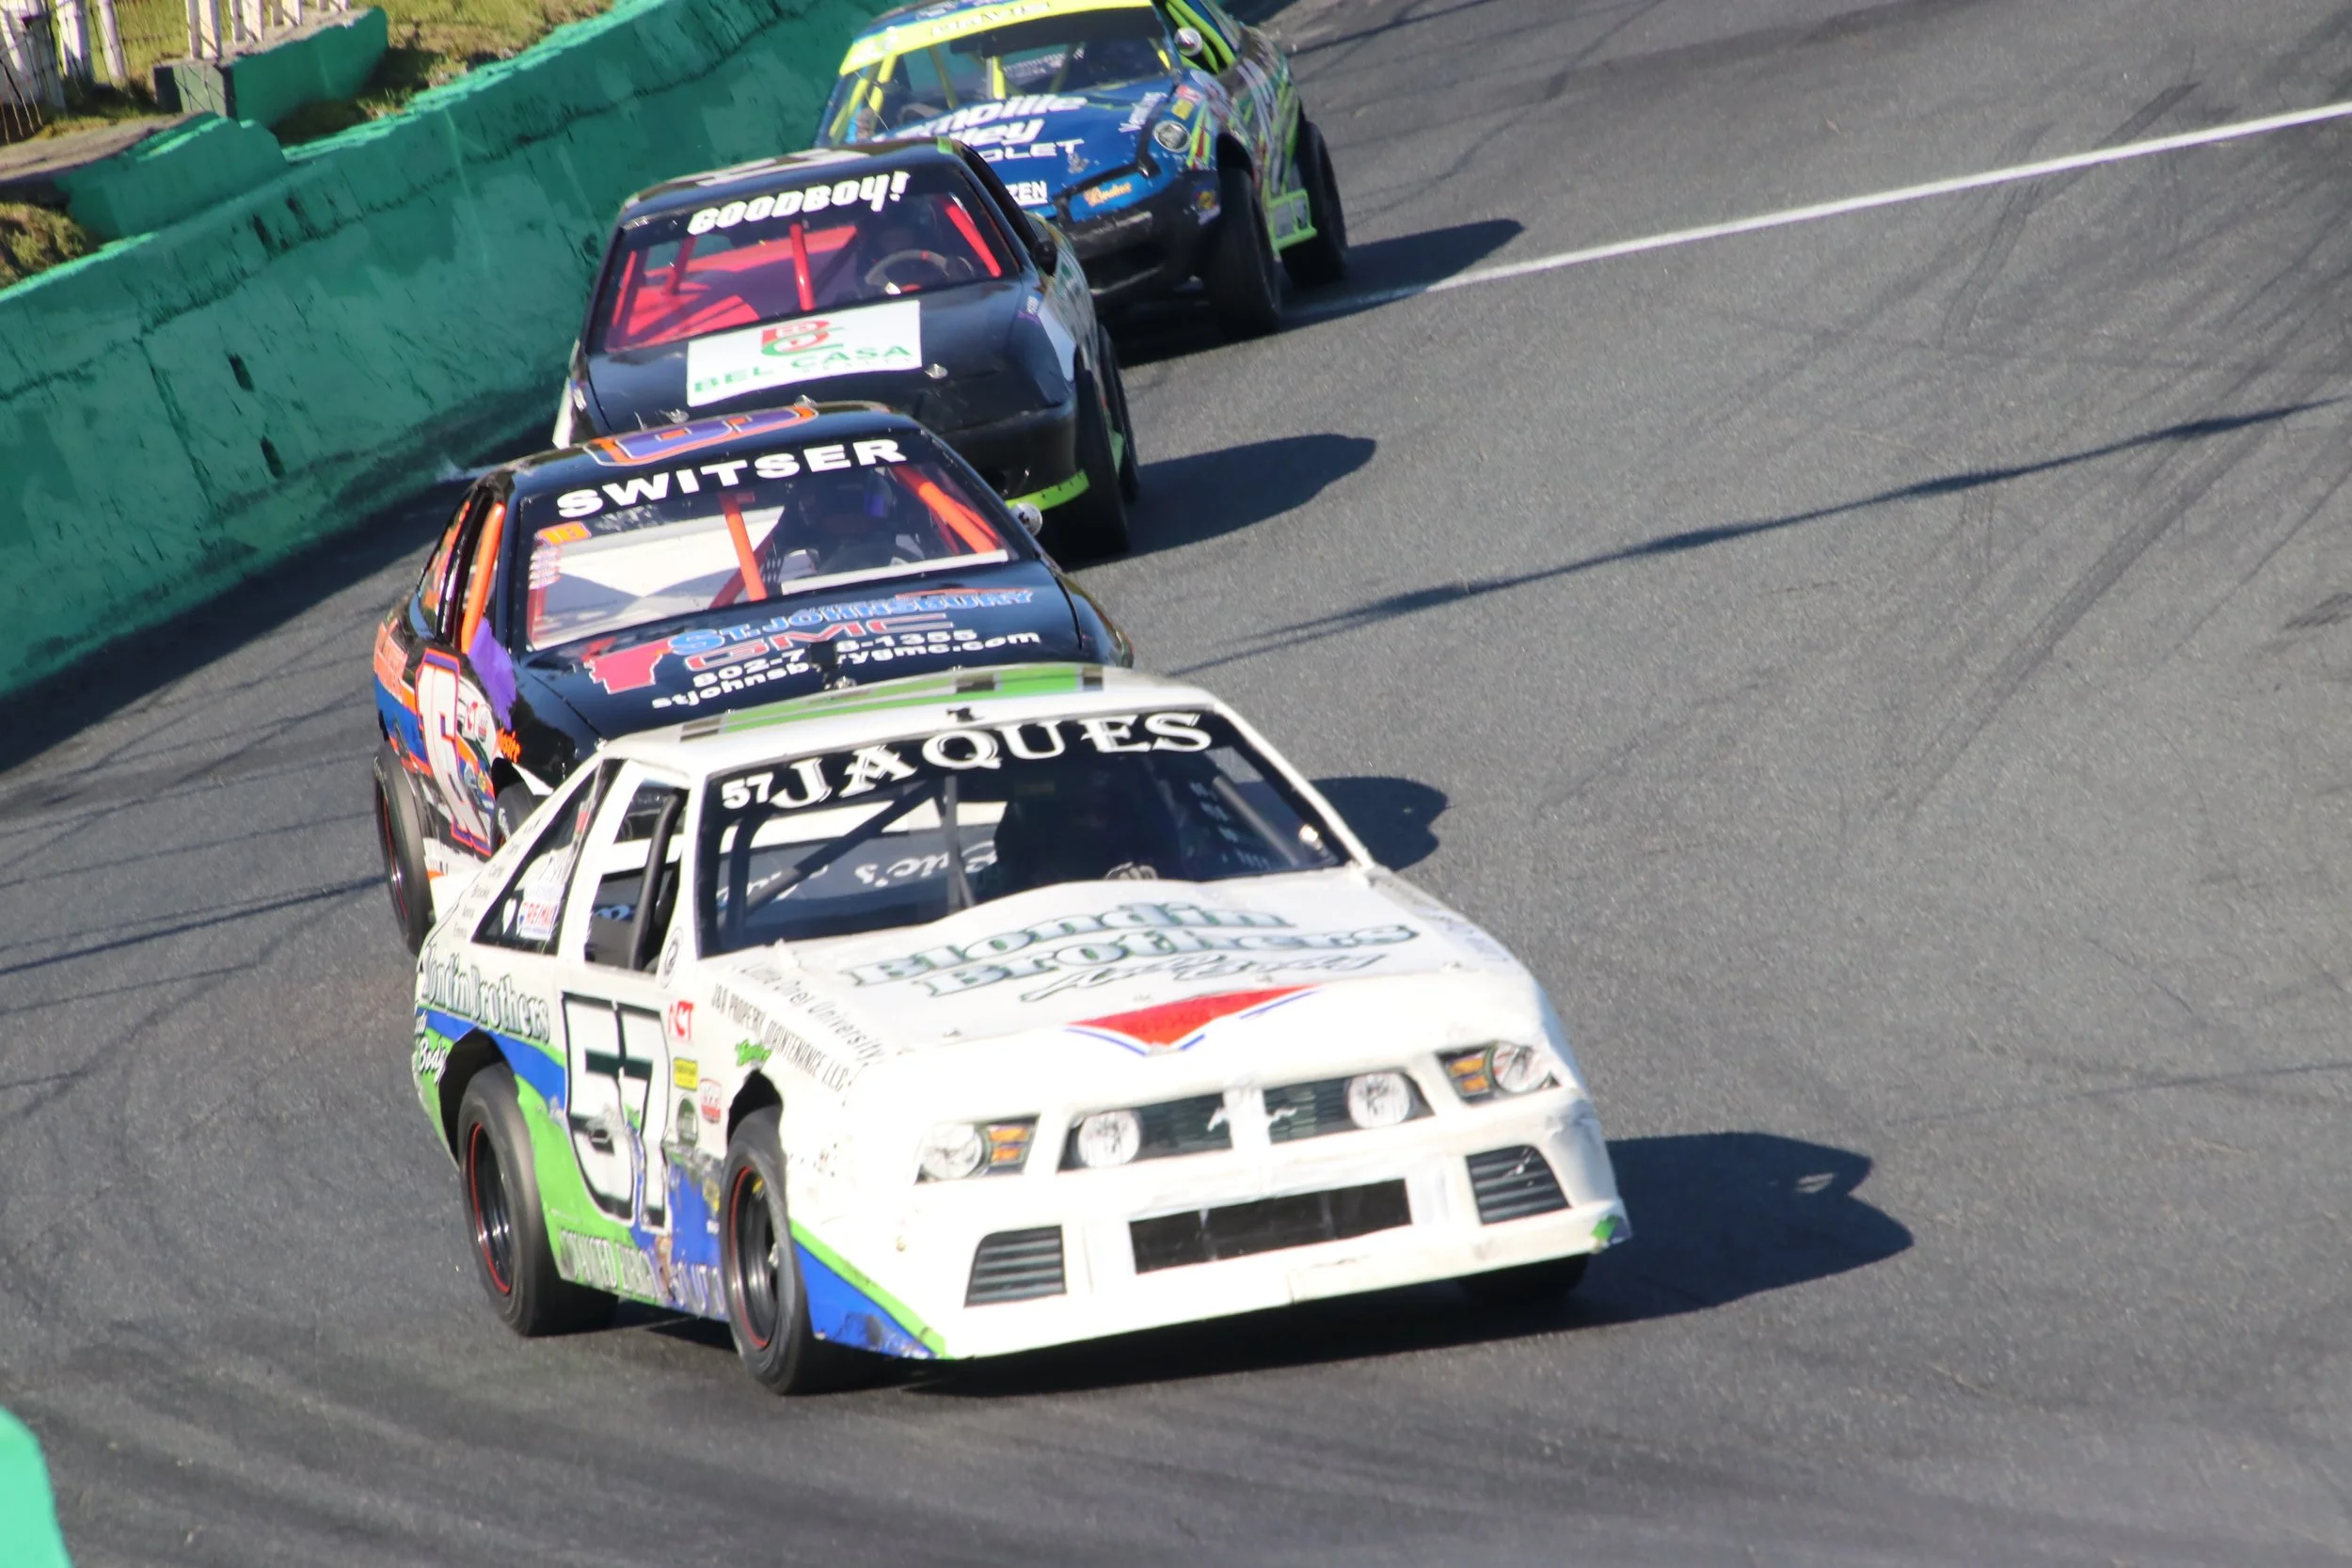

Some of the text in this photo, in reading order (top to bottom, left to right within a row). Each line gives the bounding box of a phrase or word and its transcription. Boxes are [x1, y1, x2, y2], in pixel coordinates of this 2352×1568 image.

[694, 365, 775, 393] BEL
[790, 344, 913, 371] CASA
[556, 438, 907, 518] SWITSER
[651, 630, 1041, 710] stjohnsbrygmc.com
[684, 612, 954, 673] GMC
[692, 628, 978, 689] 802-78-1355
[721, 710, 1214, 811] 57 JAQUES
[836, 901, 1298, 988] Blondin
[469, 963, 549, 1046] Brothers
[562, 990, 671, 1228] 57
[820, 1060, 850, 1093] LLC
